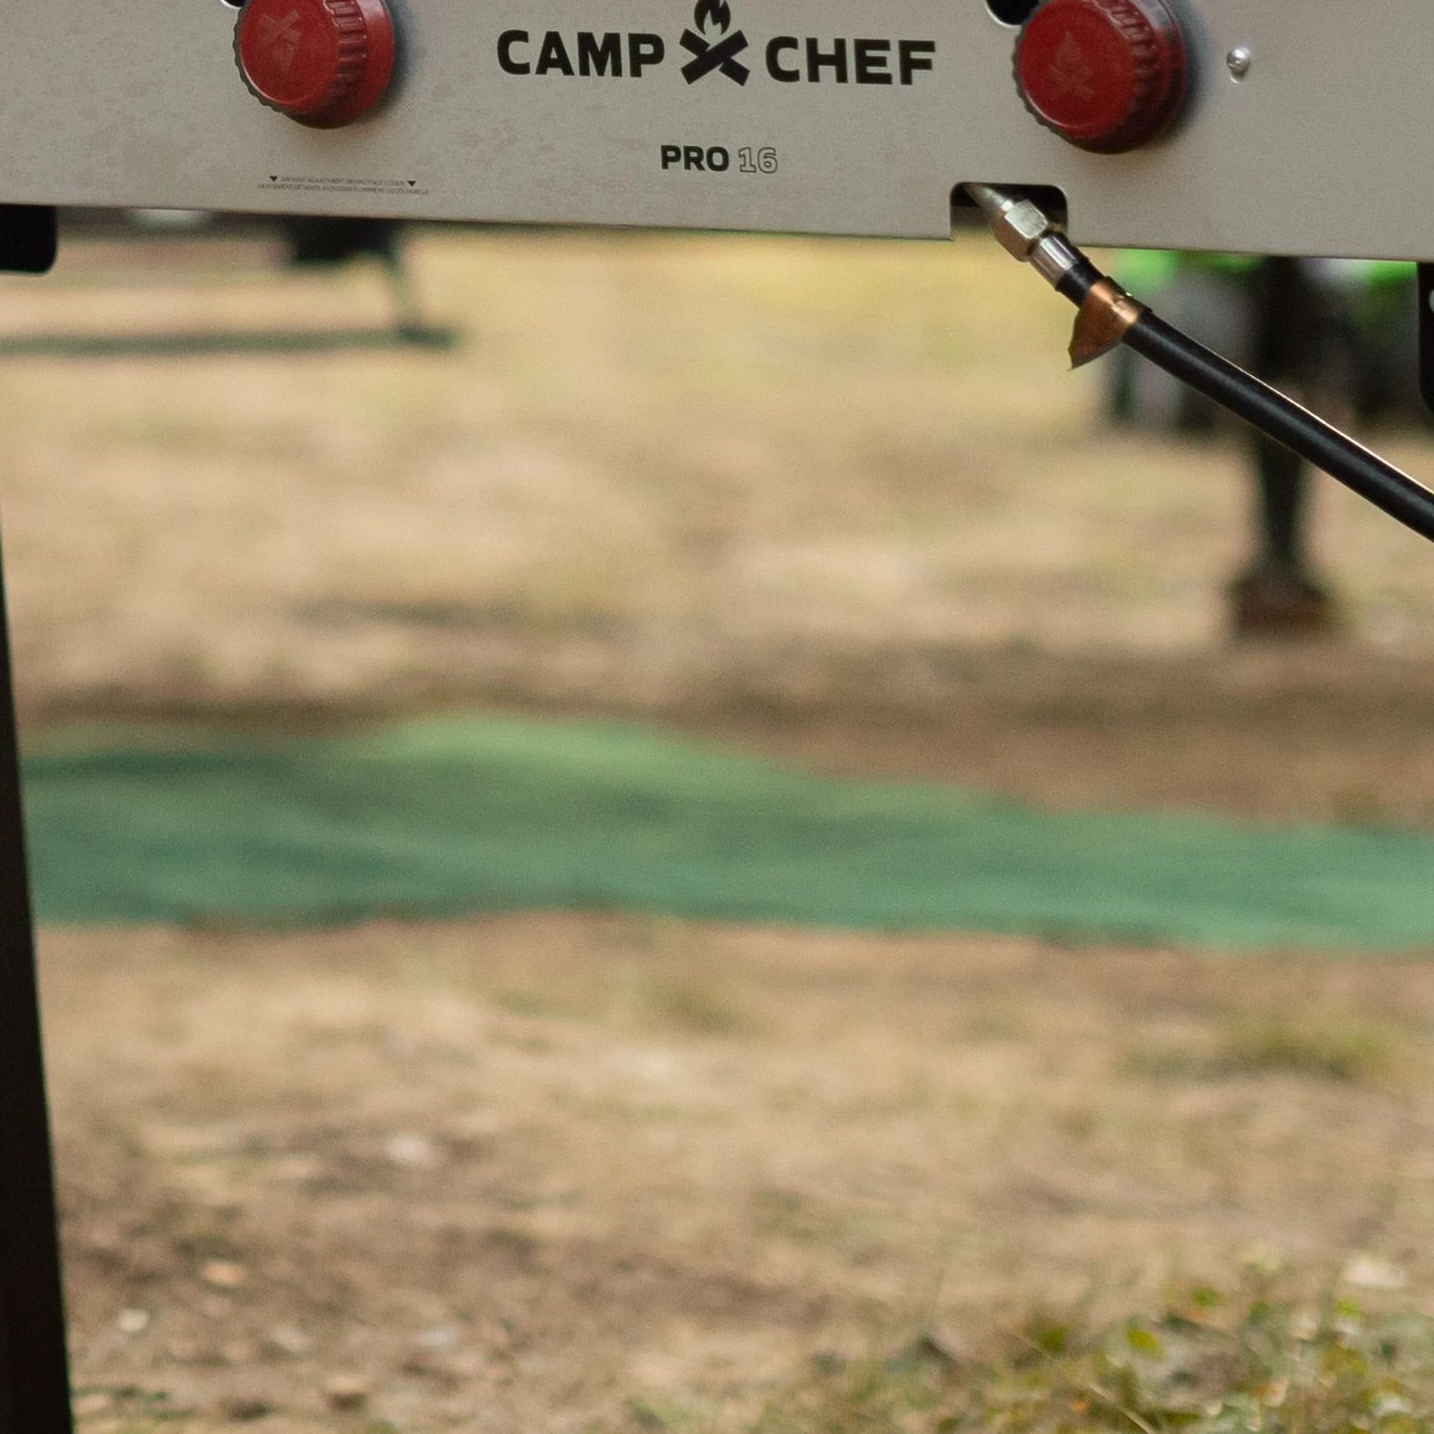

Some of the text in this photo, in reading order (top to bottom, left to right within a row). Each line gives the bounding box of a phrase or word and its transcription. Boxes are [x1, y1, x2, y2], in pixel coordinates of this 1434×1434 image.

[496, 29, 936, 86] CAMP CHEF
[660, 144, 778, 174] PRO 16
